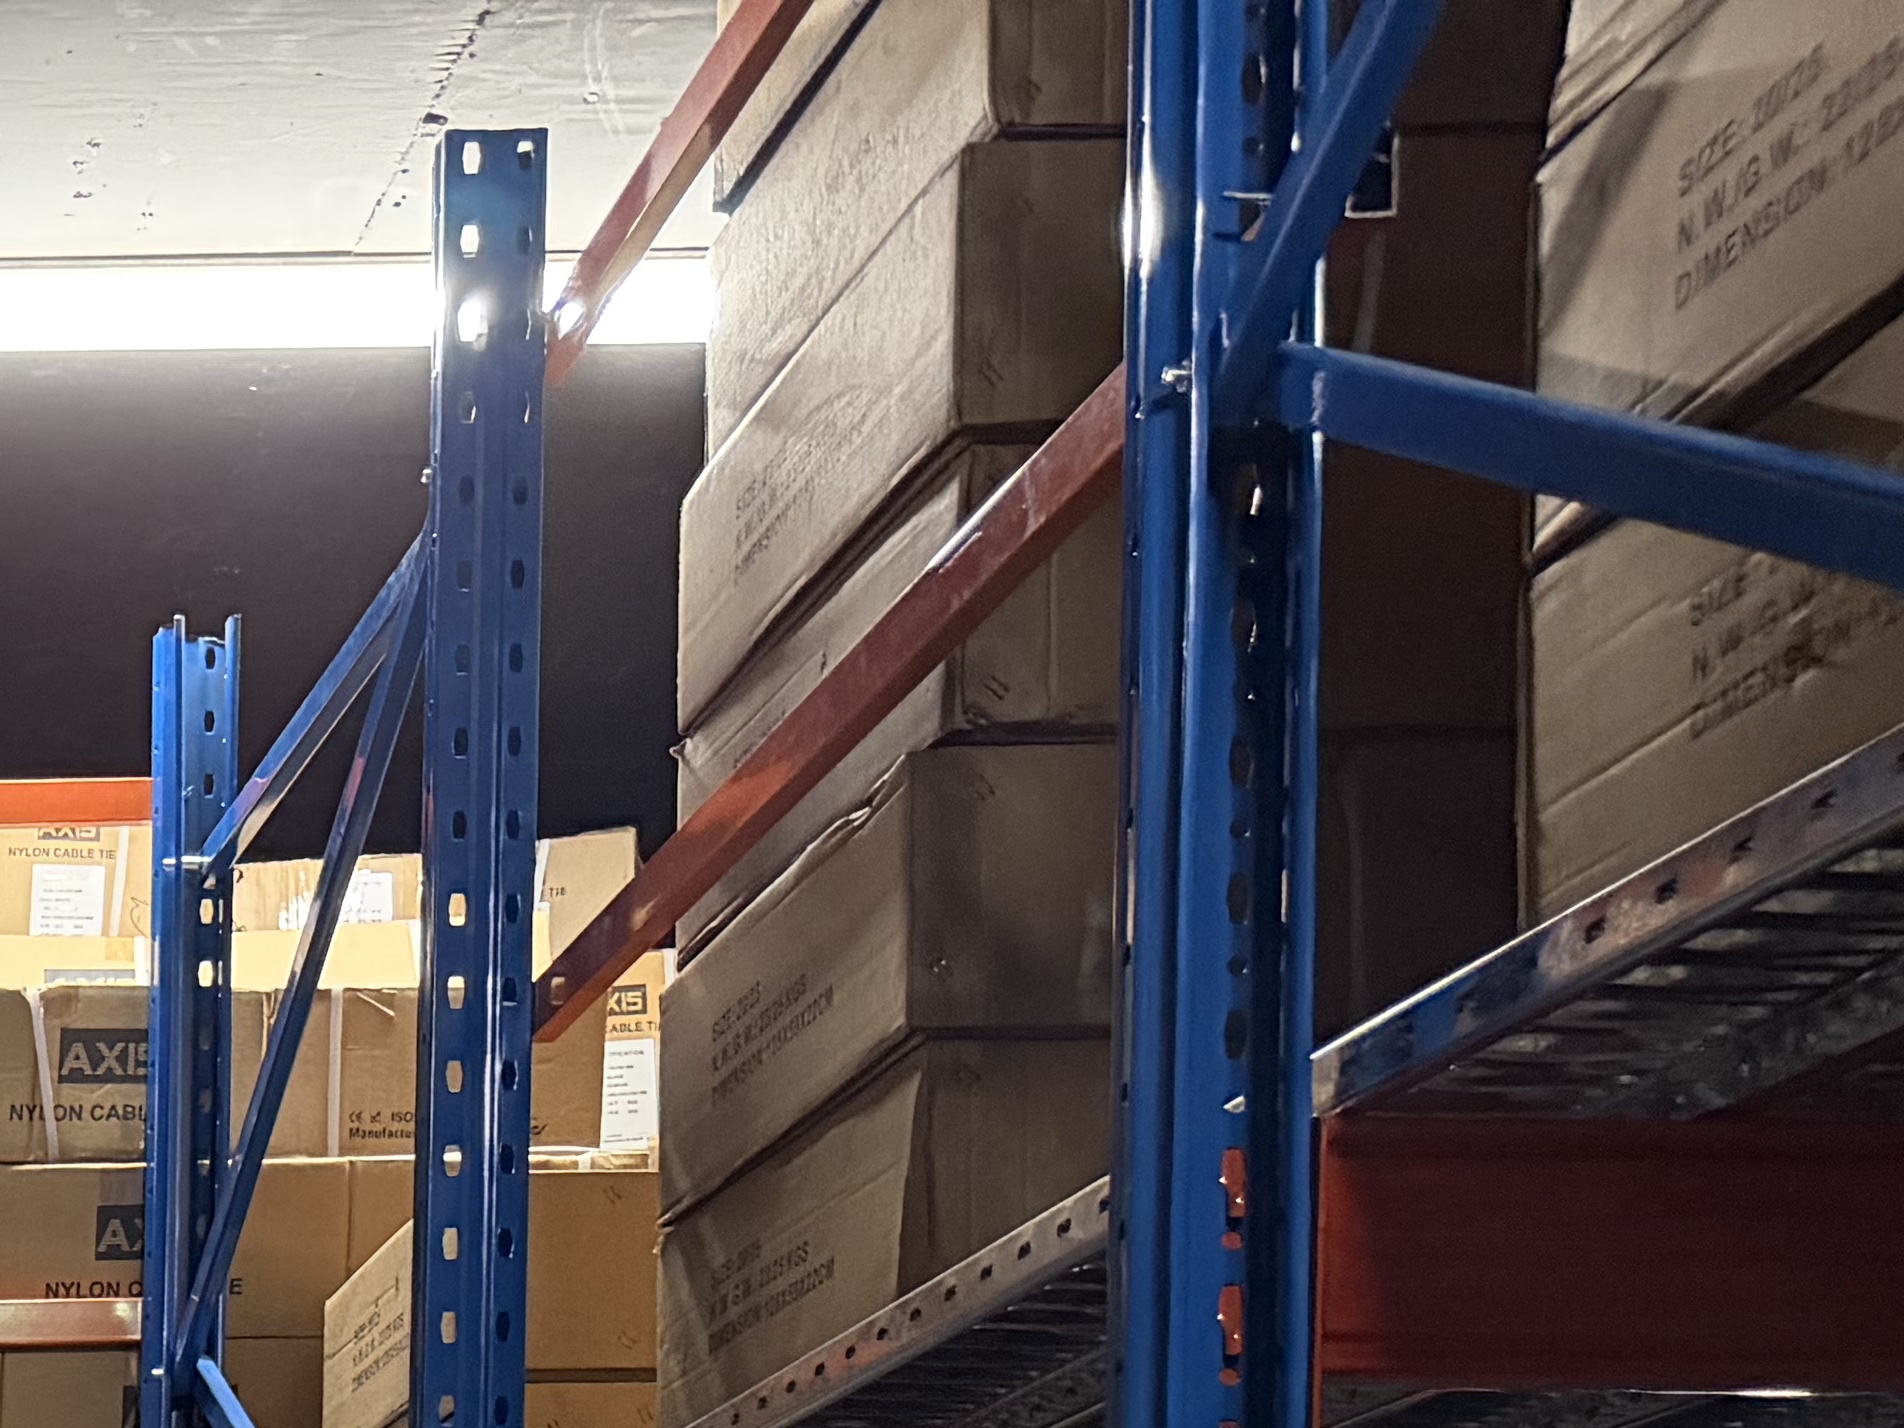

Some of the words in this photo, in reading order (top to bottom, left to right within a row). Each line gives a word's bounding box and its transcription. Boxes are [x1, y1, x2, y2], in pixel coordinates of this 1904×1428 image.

[8, 846, 50, 858] NYLON
[53, 847, 95, 860] CABLE
[99, 849, 117, 860] TIE
[606, 1021, 643, 1034] ABLE
[44, 1280, 121, 1299] NYLON
